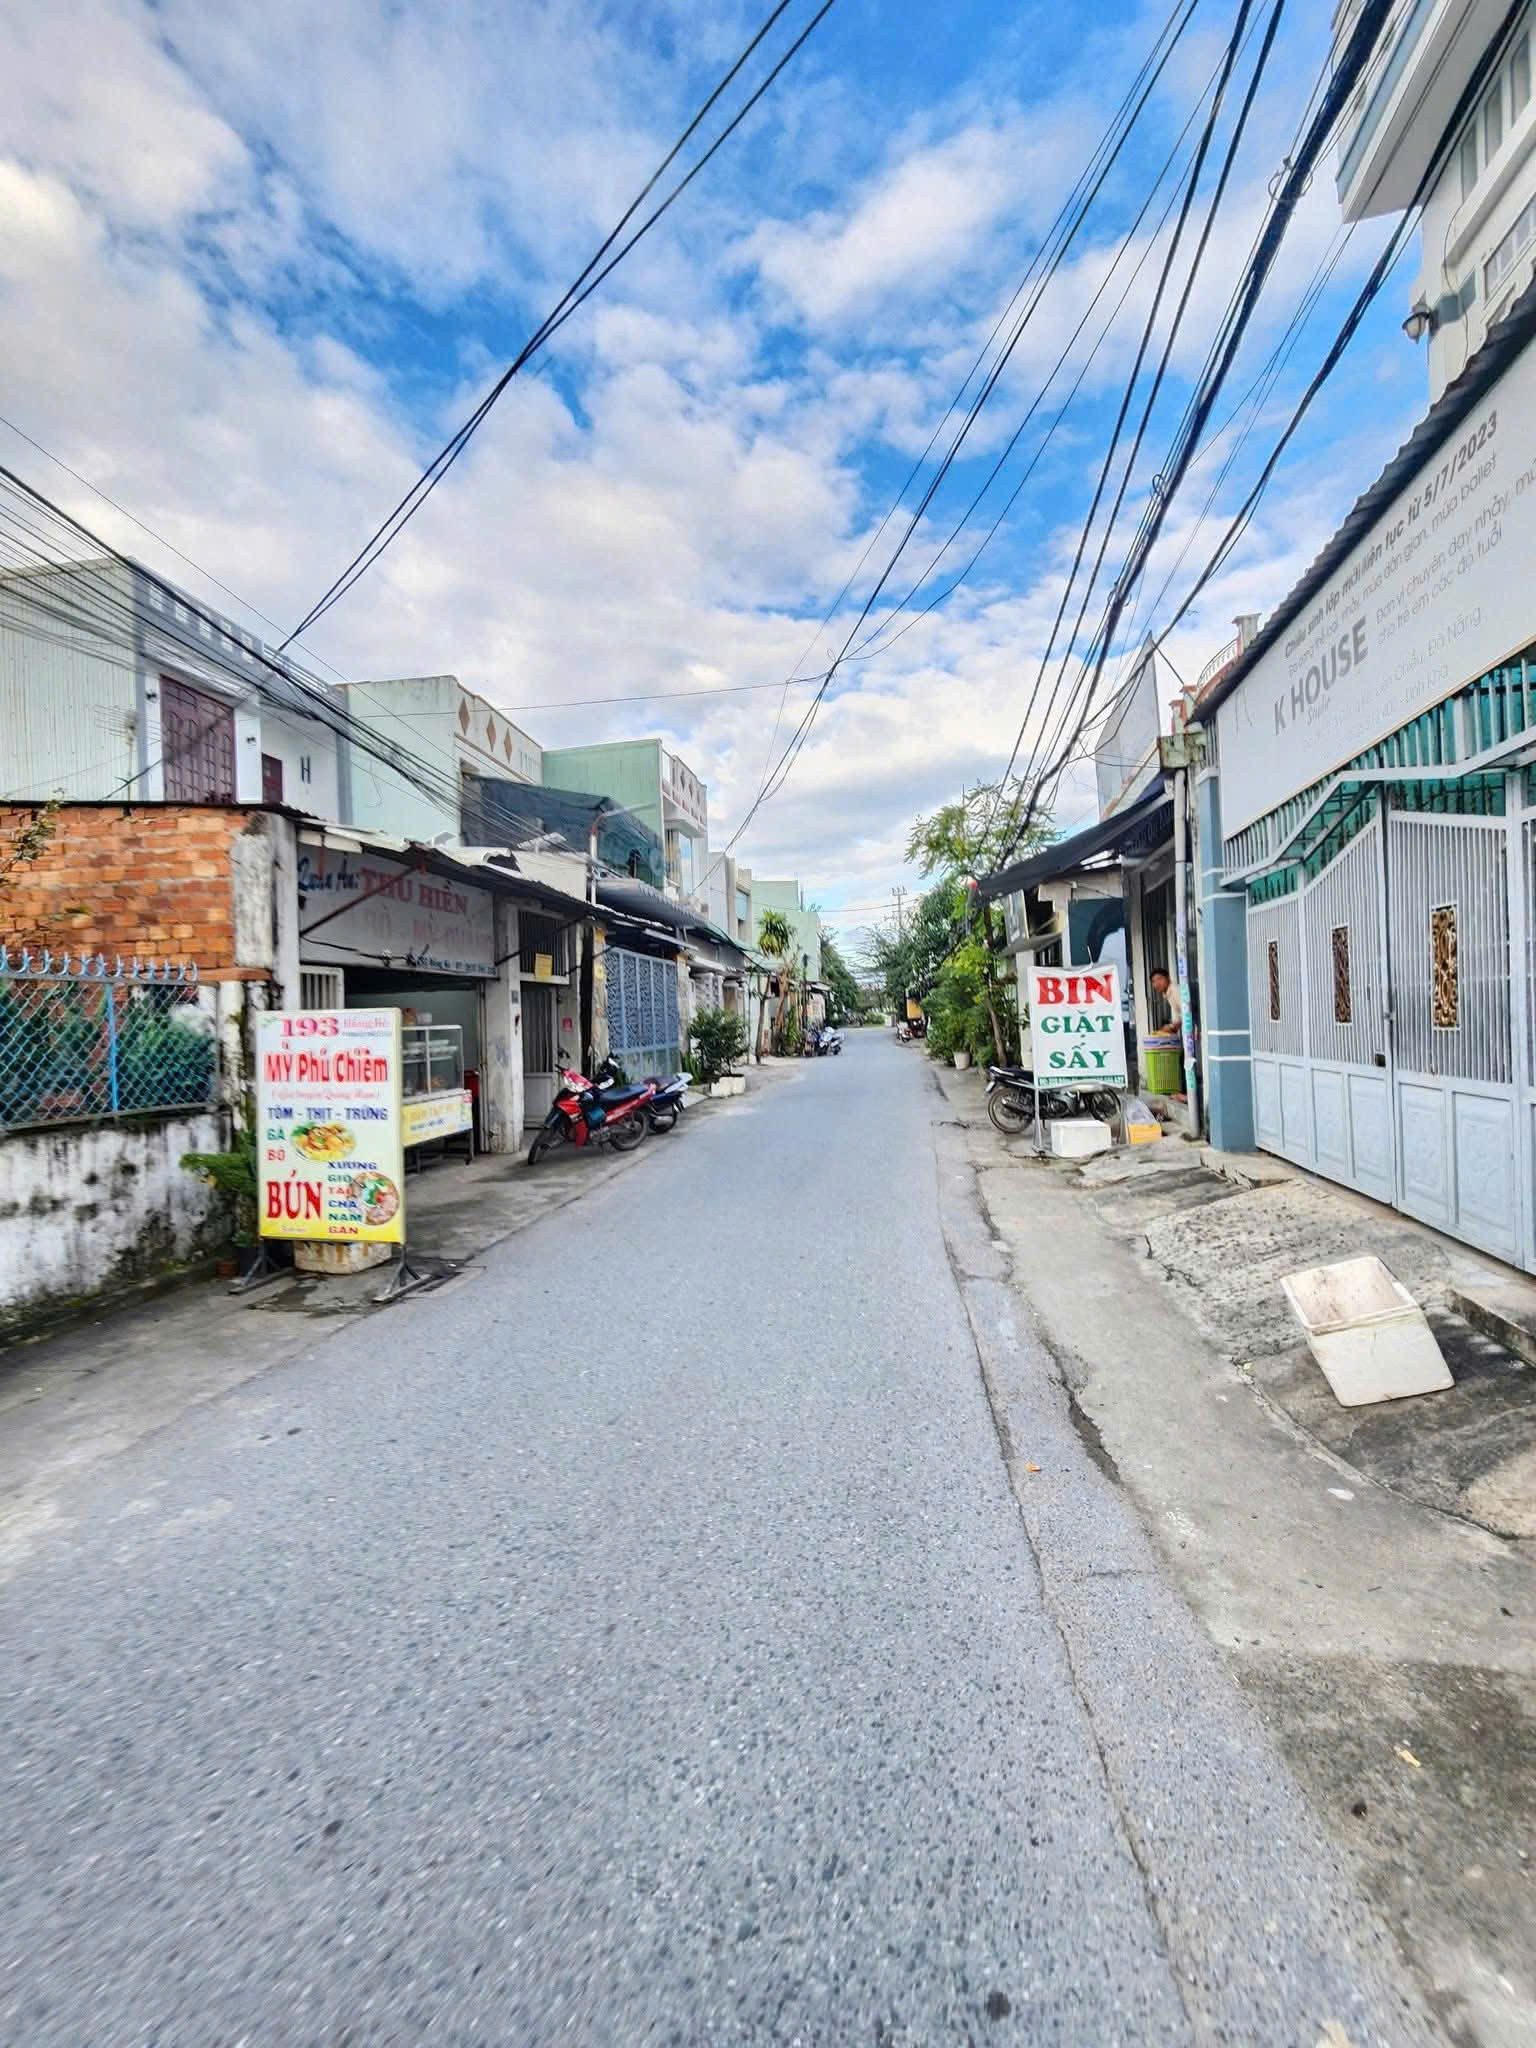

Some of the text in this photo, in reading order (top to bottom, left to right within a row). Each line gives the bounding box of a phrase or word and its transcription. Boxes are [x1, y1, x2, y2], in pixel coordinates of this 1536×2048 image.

[1404, 411, 1497, 508] 5/7/2023
[1460, 453, 1497, 501] ballet
[1407, 498, 1421, 526] từ
[1385, 518, 1404, 551] tục
[1275, 695, 1287, 736] K
[1291, 615, 1368, 721] HOUSE
[1036, 974, 1112, 1005] BIN
[280, 1016, 339, 1037] 193
[1040, 1009, 1114, 1039] GIẶT
[297, 1046, 330, 1082] Phú
[1048, 1041, 1110, 1069] SẤY
[267, 1103, 294, 1120] TÔM
[266, 1168, 323, 1220] BÚN
